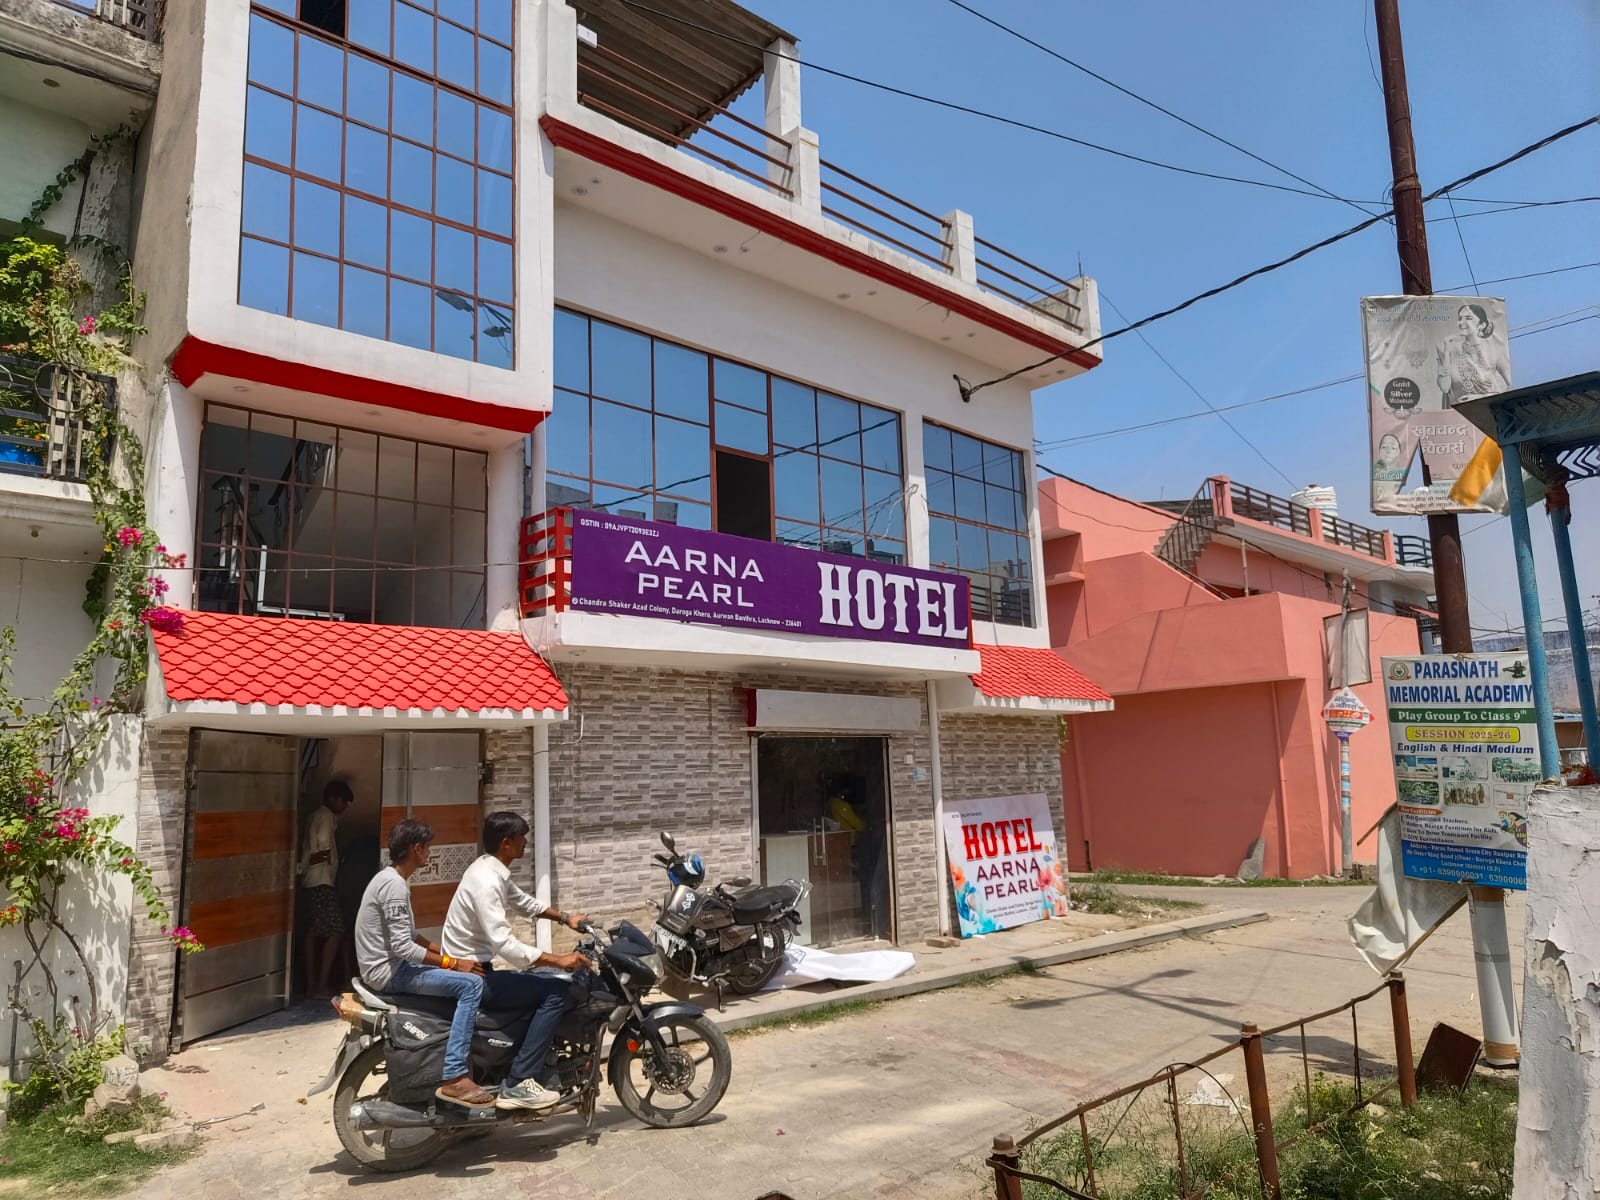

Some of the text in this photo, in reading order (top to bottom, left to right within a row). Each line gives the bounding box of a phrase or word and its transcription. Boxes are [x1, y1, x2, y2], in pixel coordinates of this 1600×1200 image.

[580, 518, 600, 528] GSTIN
[624, 540, 764, 582] AARNA
[638, 572, 754, 608] PEARL
[579, 598, 606, 606] Chandra
[608, 600, 631, 609] Shaker
[632, 602, 648, 611] Azad
[649, 604, 671, 614] Colony,
[672, 606, 692, 617] Daroga
[817, 562, 968, 640] HOTEL
[1414, 660, 1498, 679] PARASNATH
[1389, 684, 1532, 703] MEMORIAL ACADEMY
[1398, 712, 1422, 723] Play
[1424, 712, 1460, 722] Group
[1463, 712, 1478, 720] To
[1480, 712, 1510, 720] Class
[1414, 730, 1466, 738] SESSION
[1397, 742, 1534, 754] English & Hindi Medium
[961, 818, 1042, 862] HOTEL
[976, 858, 1041, 883] AARNA
[984, 878, 1039, 900] PEARL
